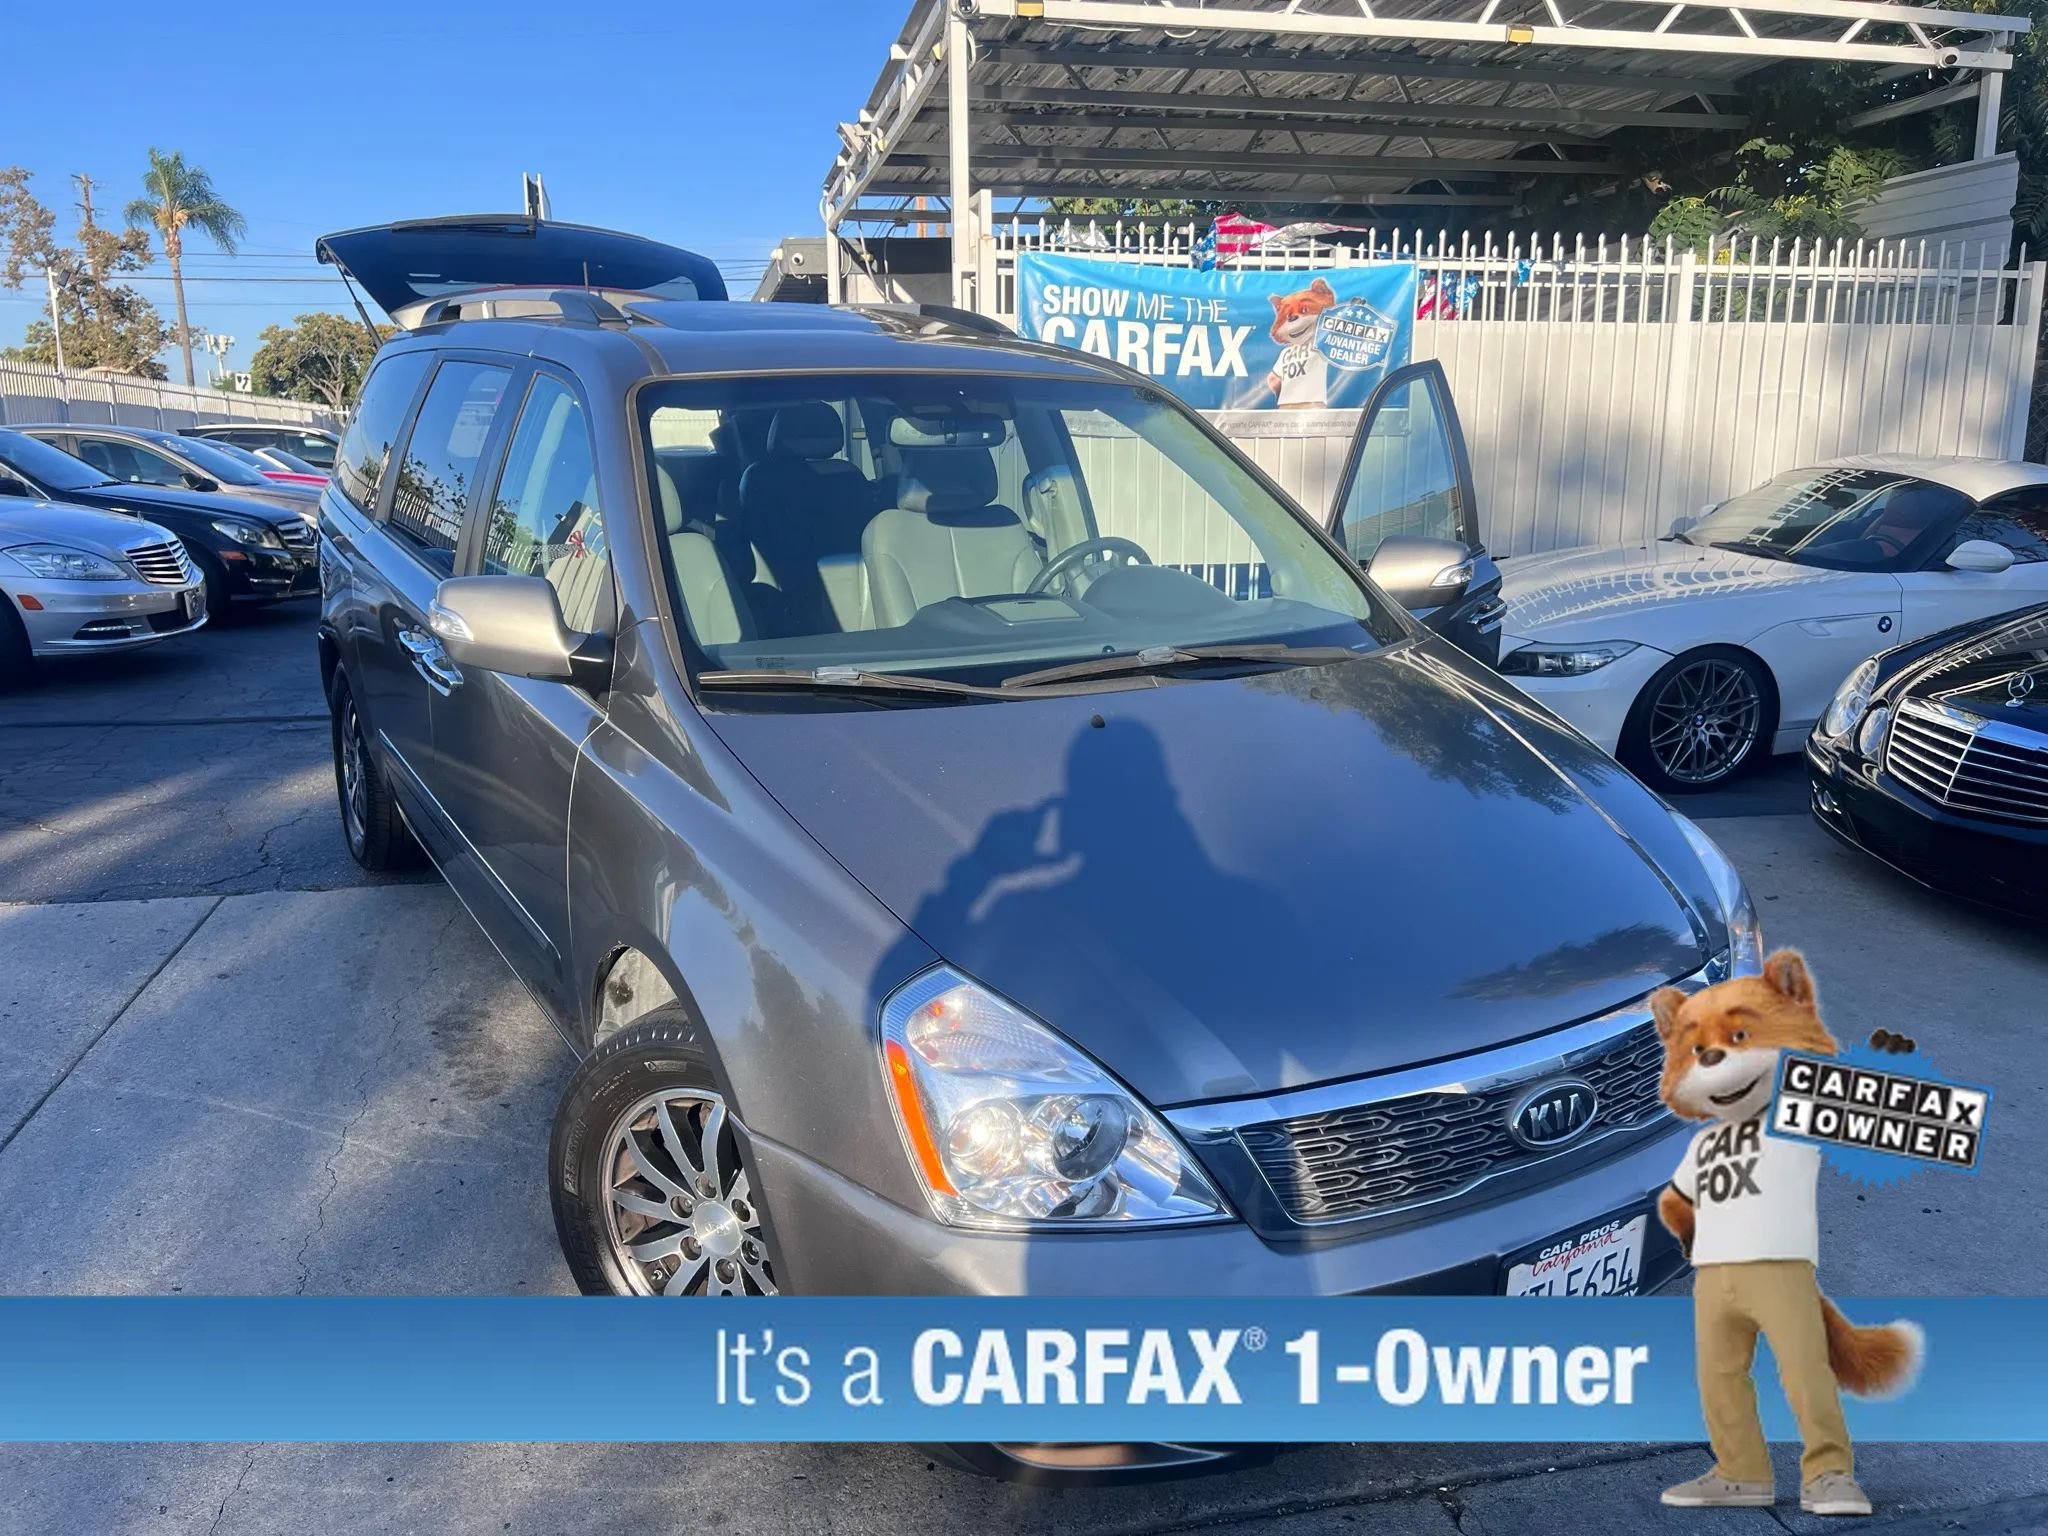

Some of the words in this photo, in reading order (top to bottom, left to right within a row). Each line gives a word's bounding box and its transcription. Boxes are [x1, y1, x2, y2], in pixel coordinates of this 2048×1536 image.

[1042, 284, 1130, 318] SHOW
[1136, 291, 1176, 321] ME
[1180, 296, 1228, 323] THE
[1324, 319, 1388, 342] CARFAX
[1324, 334, 1381, 355] ADVANTAGE
[1041, 316, 1254, 377] CARFAX
[1282, 342, 1309, 364] CAR
[1329, 348, 1369, 365] DEALER
[1282, 359, 1308, 378] FOX
[1528, 1092, 1587, 1139] KIA
[1531, 1231, 1622, 1278] California
[1539, 1240, 1572, 1260] CAR
[1579, 1219, 1621, 1243] PROS
